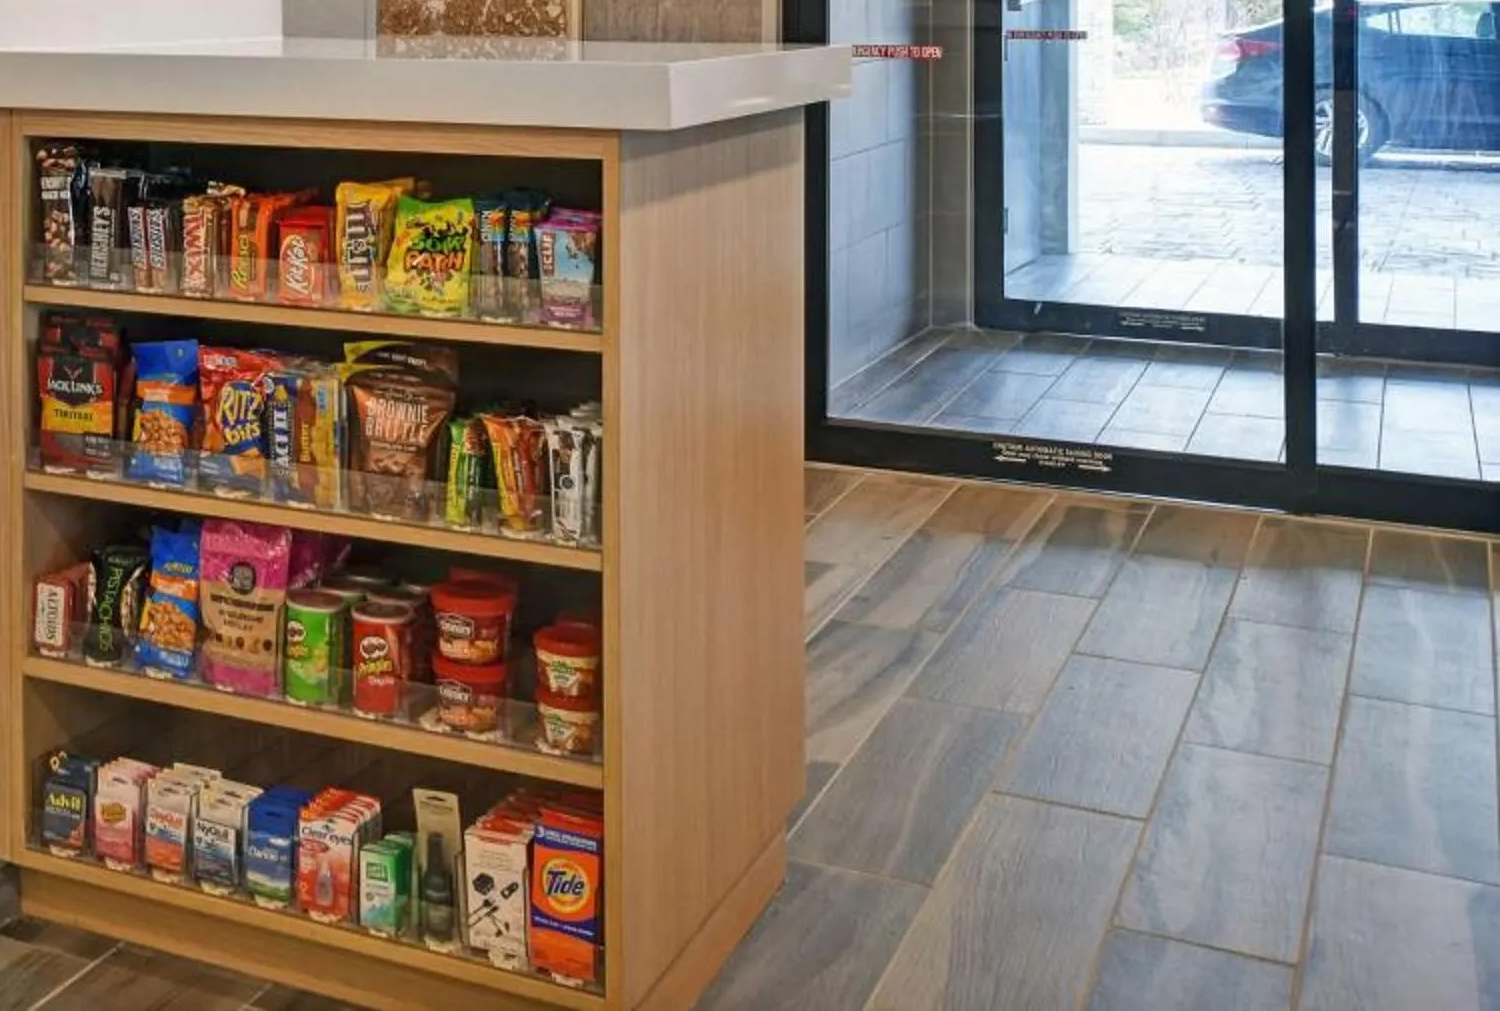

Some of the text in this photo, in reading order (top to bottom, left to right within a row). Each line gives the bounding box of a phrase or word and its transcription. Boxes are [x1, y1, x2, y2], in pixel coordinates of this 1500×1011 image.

[219, 383, 264, 427] RITZ
[366, 396, 430, 424] BROWNIE
[547, 868, 585, 897] Tide
